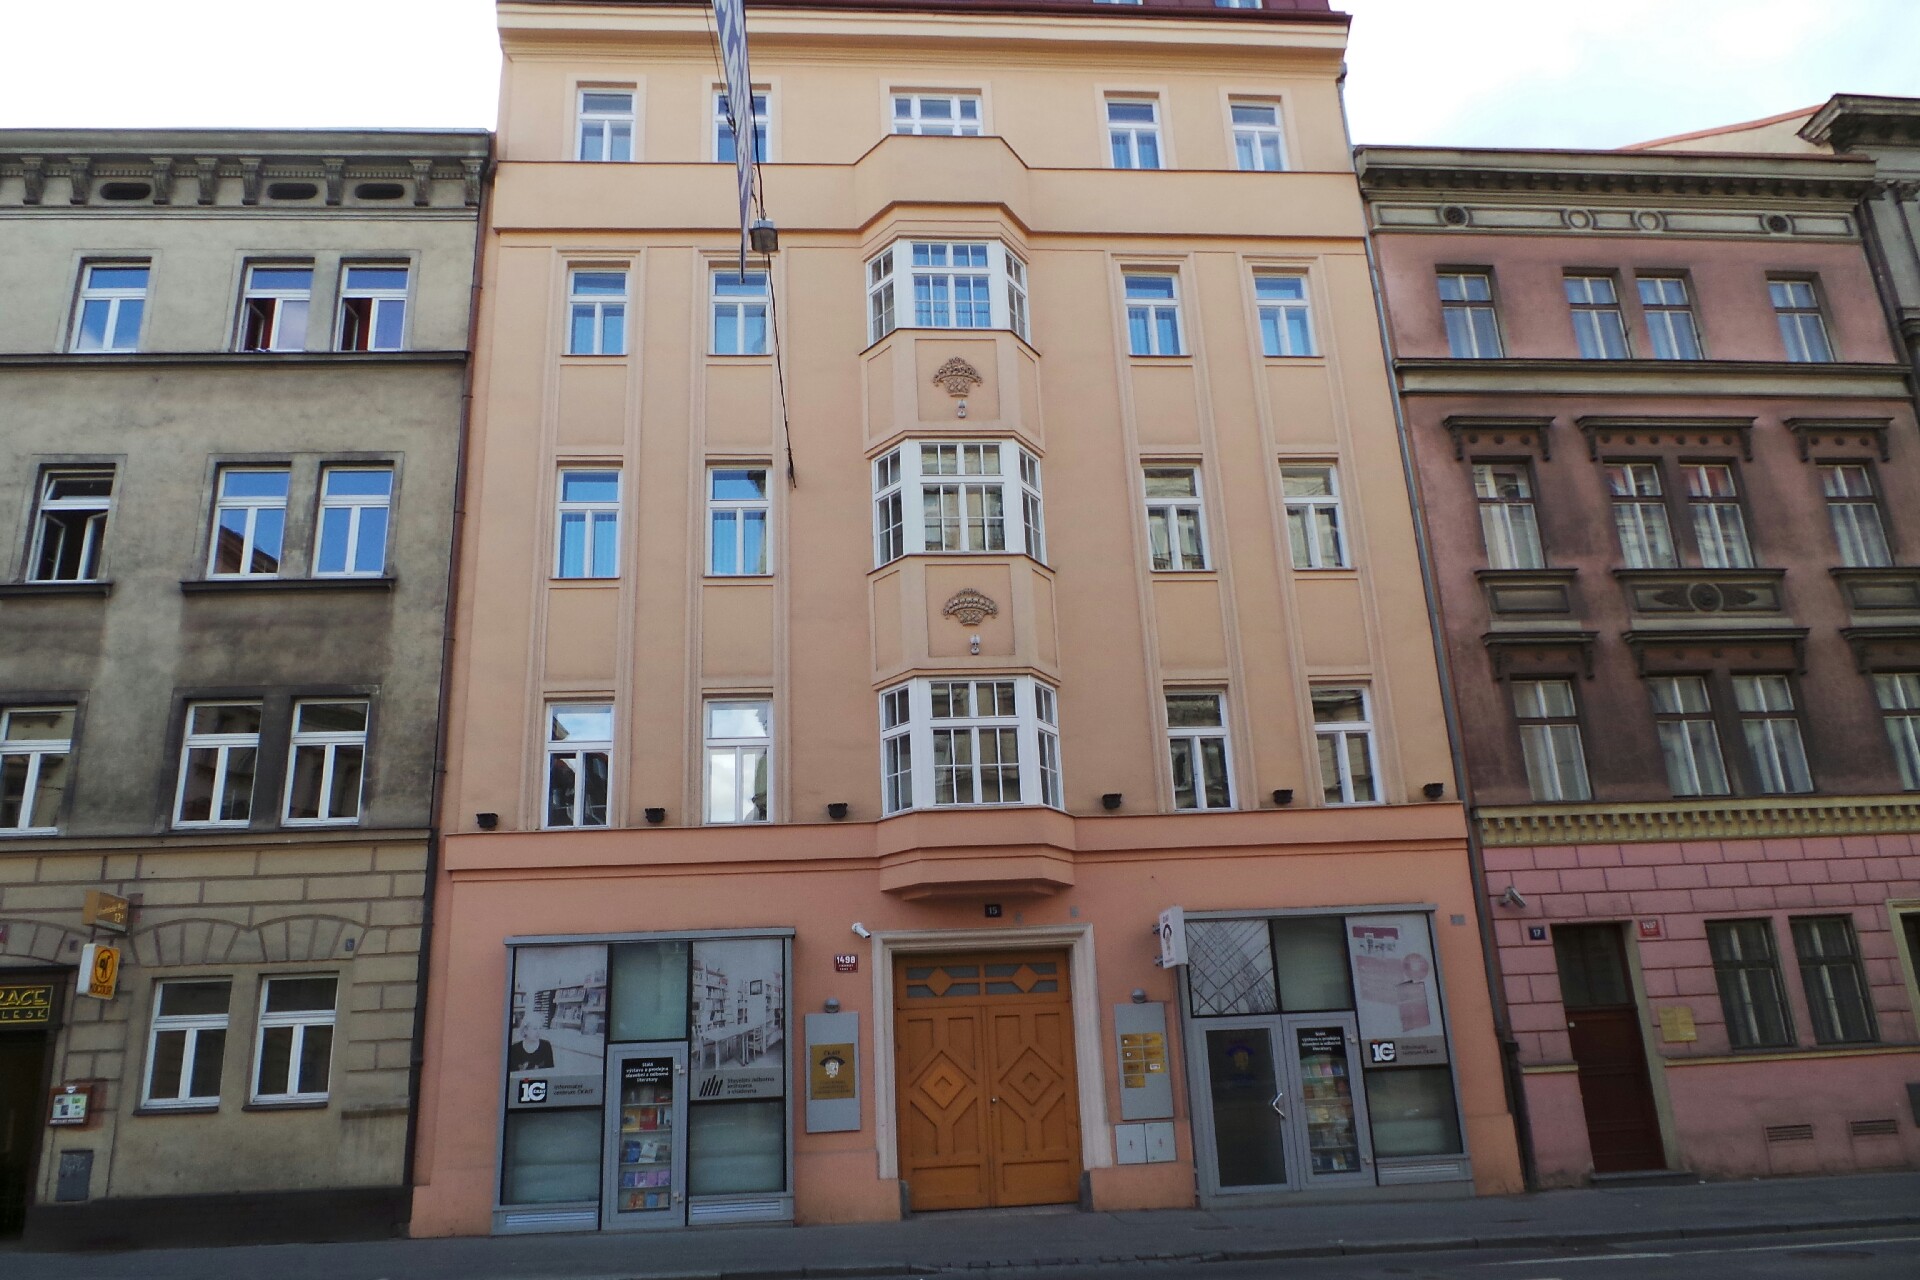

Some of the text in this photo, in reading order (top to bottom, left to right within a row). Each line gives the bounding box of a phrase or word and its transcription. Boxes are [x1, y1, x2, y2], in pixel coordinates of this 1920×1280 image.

[989, 906, 998, 915] 15
[1533, 929, 1541, 937] 17
[836, 955, 856, 964] 1498
